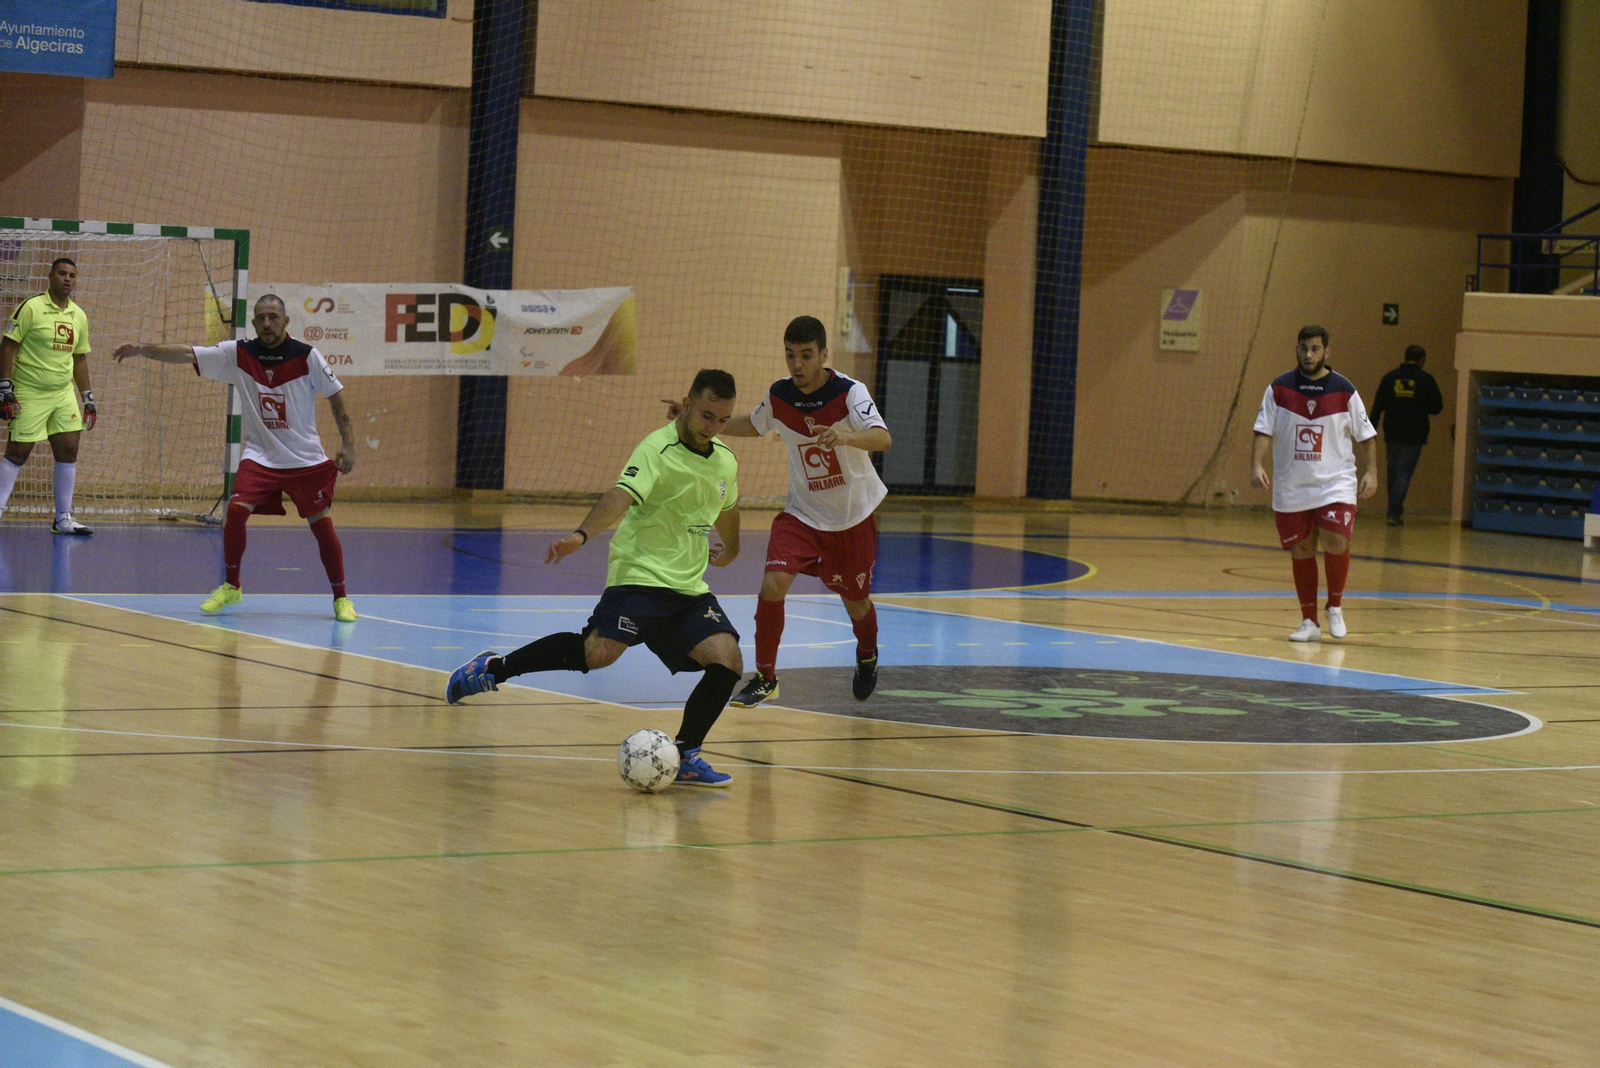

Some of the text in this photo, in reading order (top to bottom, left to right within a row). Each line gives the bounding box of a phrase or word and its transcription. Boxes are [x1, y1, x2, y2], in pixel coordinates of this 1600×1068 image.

[0, 20, 85, 38] Ayuntamiento
[15, 36, 84, 54] Algeciras
[325, 332, 349, 340] ONCE
[1294, 452, 1322, 462] KALMAR
[808, 475, 846, 492] KALMAR
